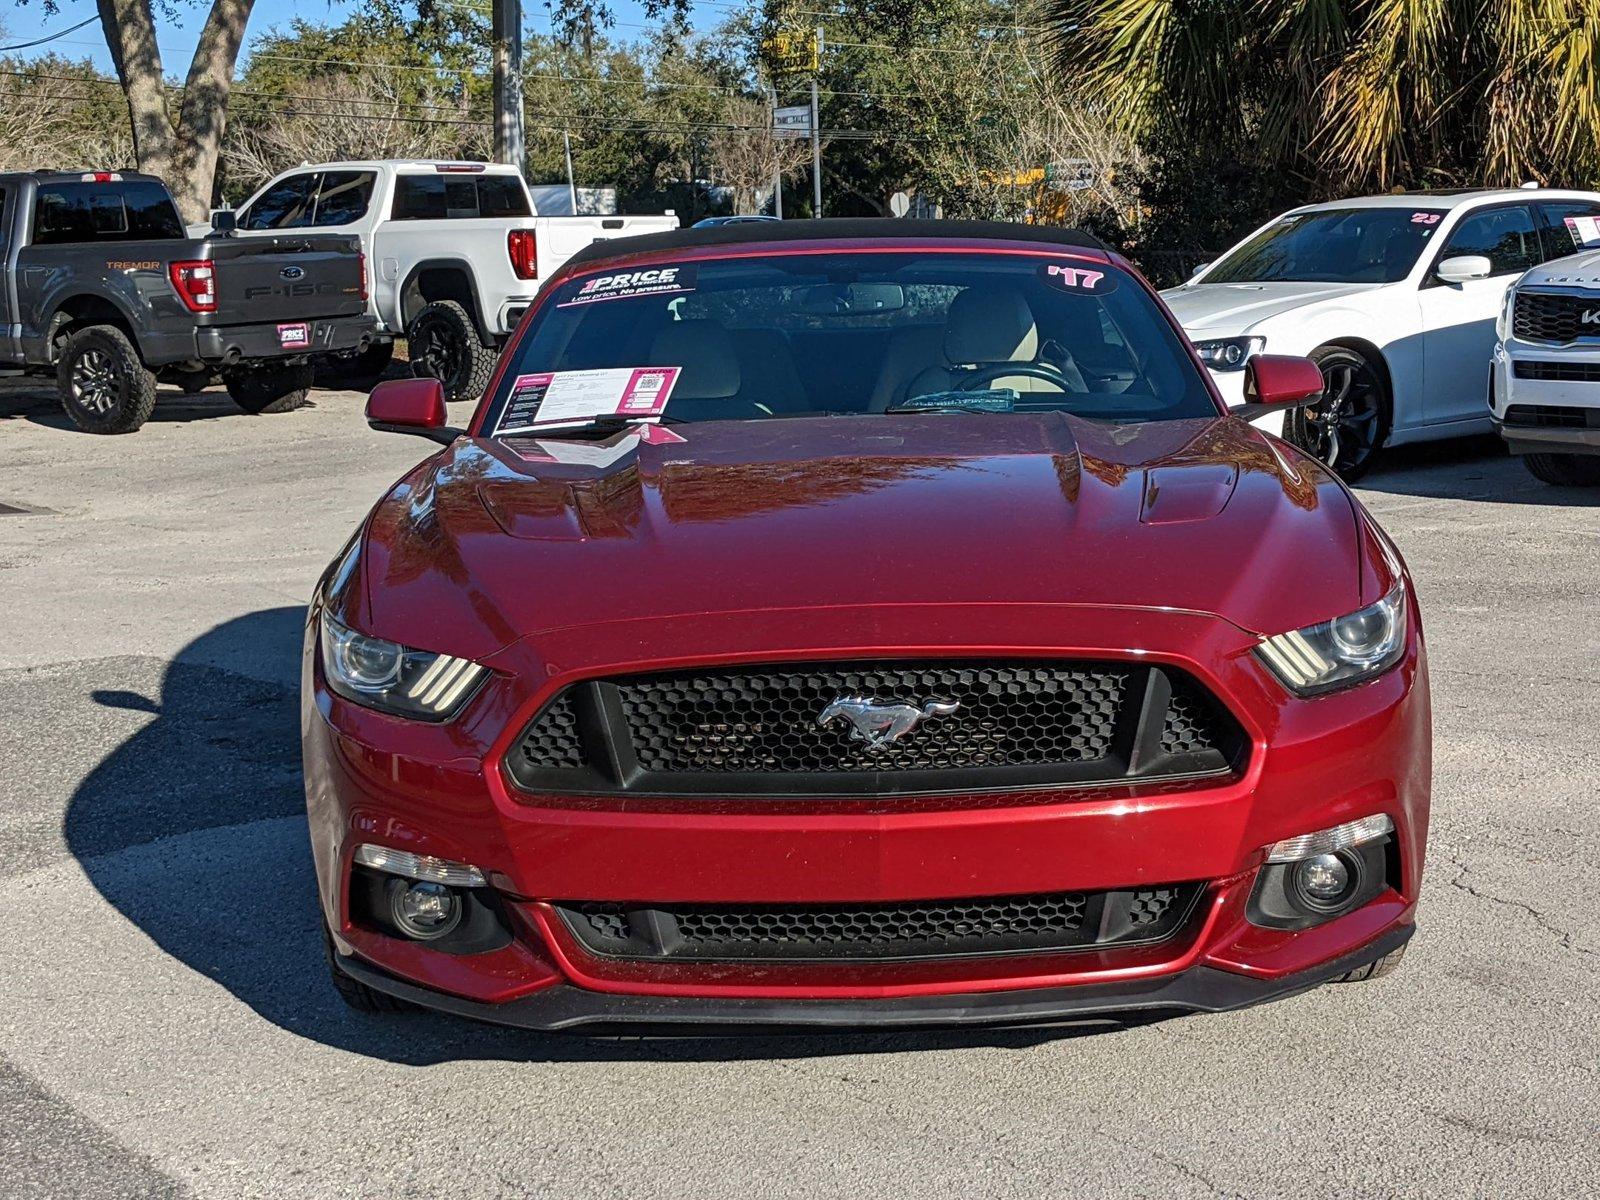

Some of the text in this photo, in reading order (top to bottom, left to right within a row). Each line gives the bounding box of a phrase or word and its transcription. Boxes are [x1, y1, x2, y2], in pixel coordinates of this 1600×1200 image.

[1410, 212, 1440, 224] 23
[106, 261, 160, 270] TREMOR
[582, 268, 680, 291] 1PRICE
[1048, 265, 1104, 288] '17
[571, 295, 592, 303] Low
[636, 284, 681, 293] pressure.
